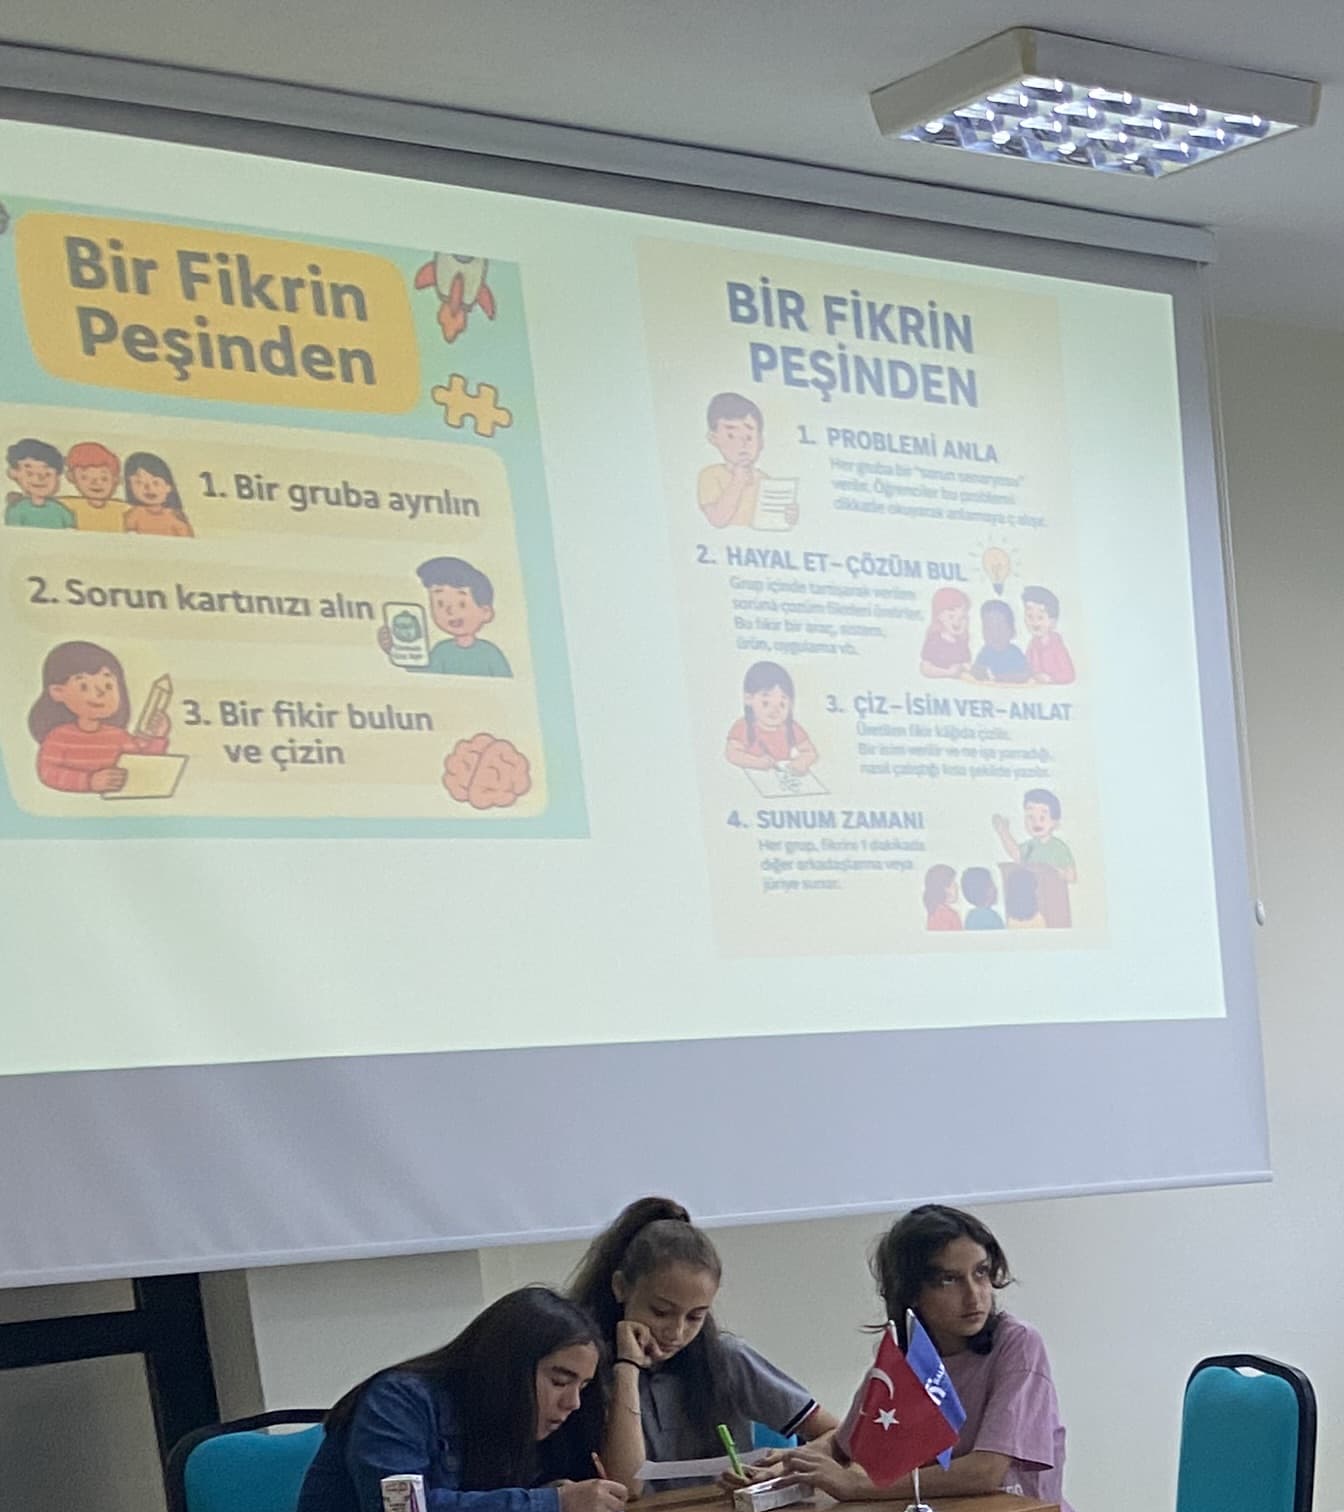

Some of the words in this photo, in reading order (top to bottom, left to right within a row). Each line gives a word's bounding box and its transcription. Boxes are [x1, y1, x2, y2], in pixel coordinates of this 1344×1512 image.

[64, 235, 158, 296] Bir
[178, 249, 368, 321] Fikrin
[727, 277, 809, 332] BİR
[823, 289, 975, 354] FİKRİN
[76, 305, 377, 385] Peşinden
[749, 341, 979, 408] PEŞİNDEN
[797, 425, 816, 445] 1.
[826, 427, 938, 458] PROBLEMİ
[943, 440, 998, 464] ANLA
[201, 471, 228, 500] 1.
[235, 473, 279, 503] Bir
[289, 480, 379, 516] gruba
[389, 487, 480, 519] ayrılın
[696, 544, 716, 565] 2.
[726, 546, 797, 571] HAYAL
[928, 562, 968, 581] BUL
[27, 577, 59, 604] 2.
[65, 578, 167, 611] Sorun
[176, 585, 310, 620] kartınızı
[320, 594, 374, 620] alın
[182, 700, 211, 726] 3.
[219, 701, 264, 728] Bir
[272, 701, 340, 731] fikir
[348, 703, 433, 732] bulun
[826, 696, 844, 713] 3.
[224, 743, 262, 765] ve
[271, 741, 345, 771] çizin
[727, 811, 749, 829] 4.
[757, 810, 836, 830] SUNUM
[842, 811, 924, 830] ZAMANI
